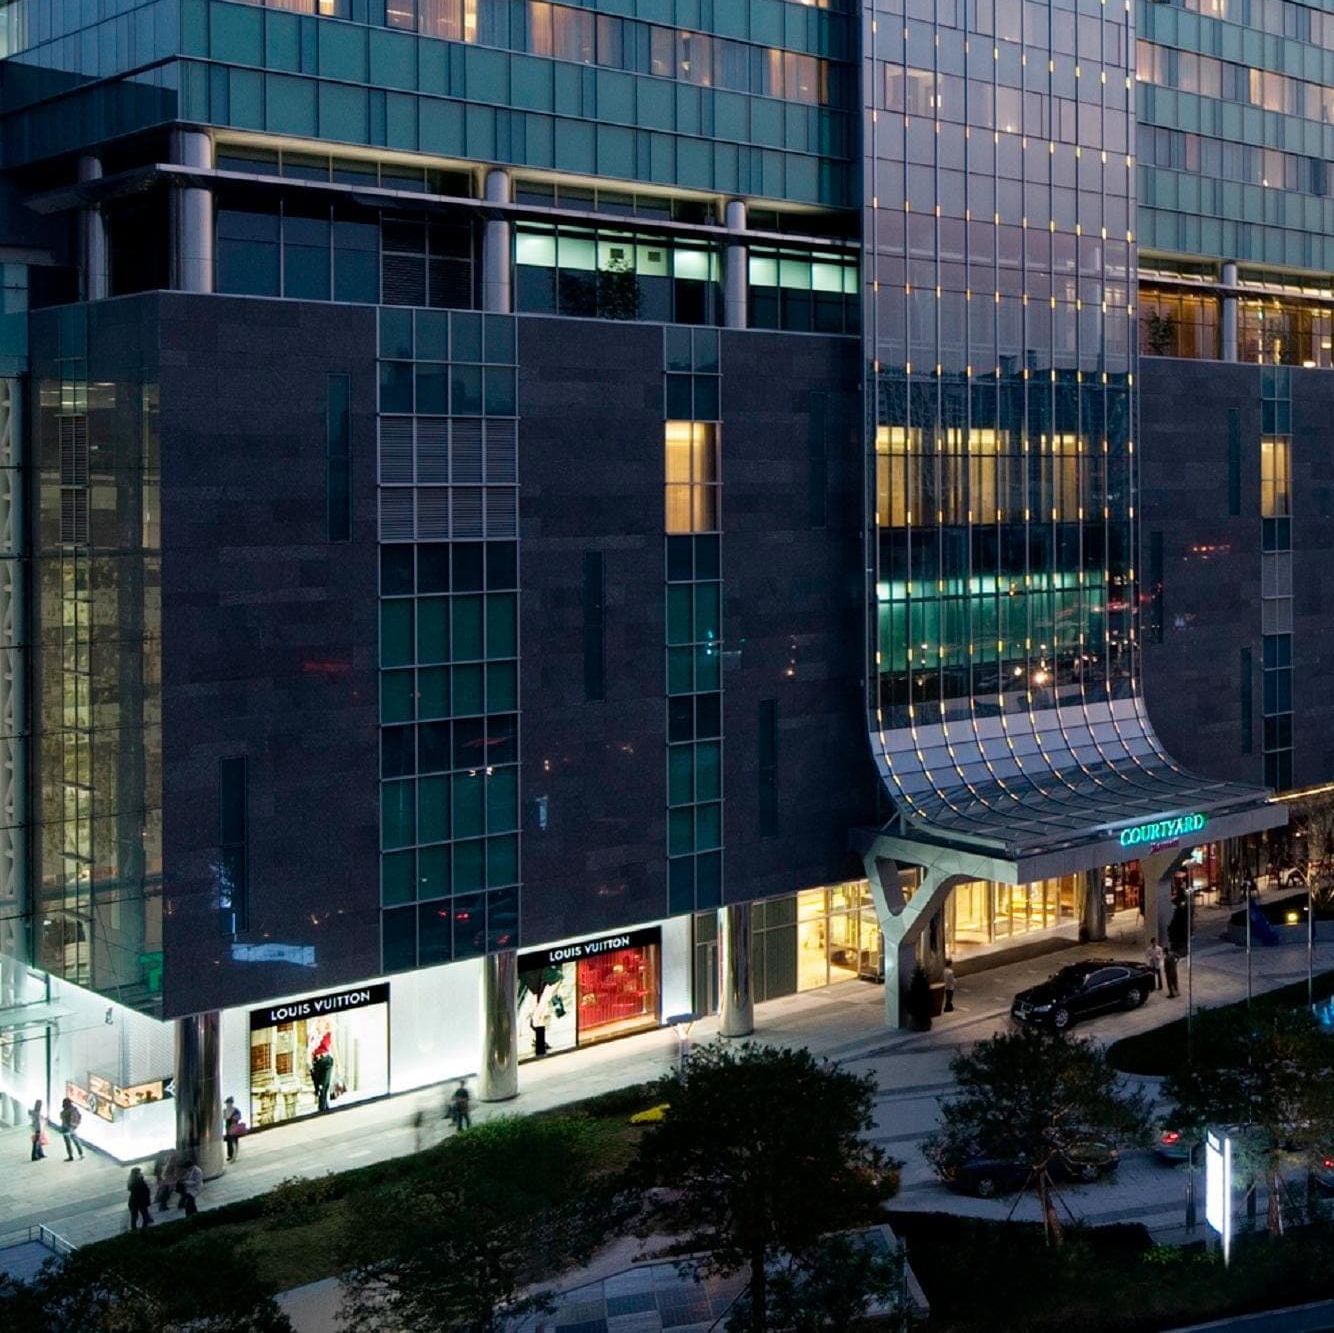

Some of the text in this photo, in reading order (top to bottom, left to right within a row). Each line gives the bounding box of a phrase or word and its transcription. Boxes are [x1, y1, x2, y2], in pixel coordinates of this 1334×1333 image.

[1120, 813, 1205, 847] COURTYARD
[548, 935, 631, 963] LOUIS VUITTON
[270, 990, 371, 1021] LOUIS VUITTON
